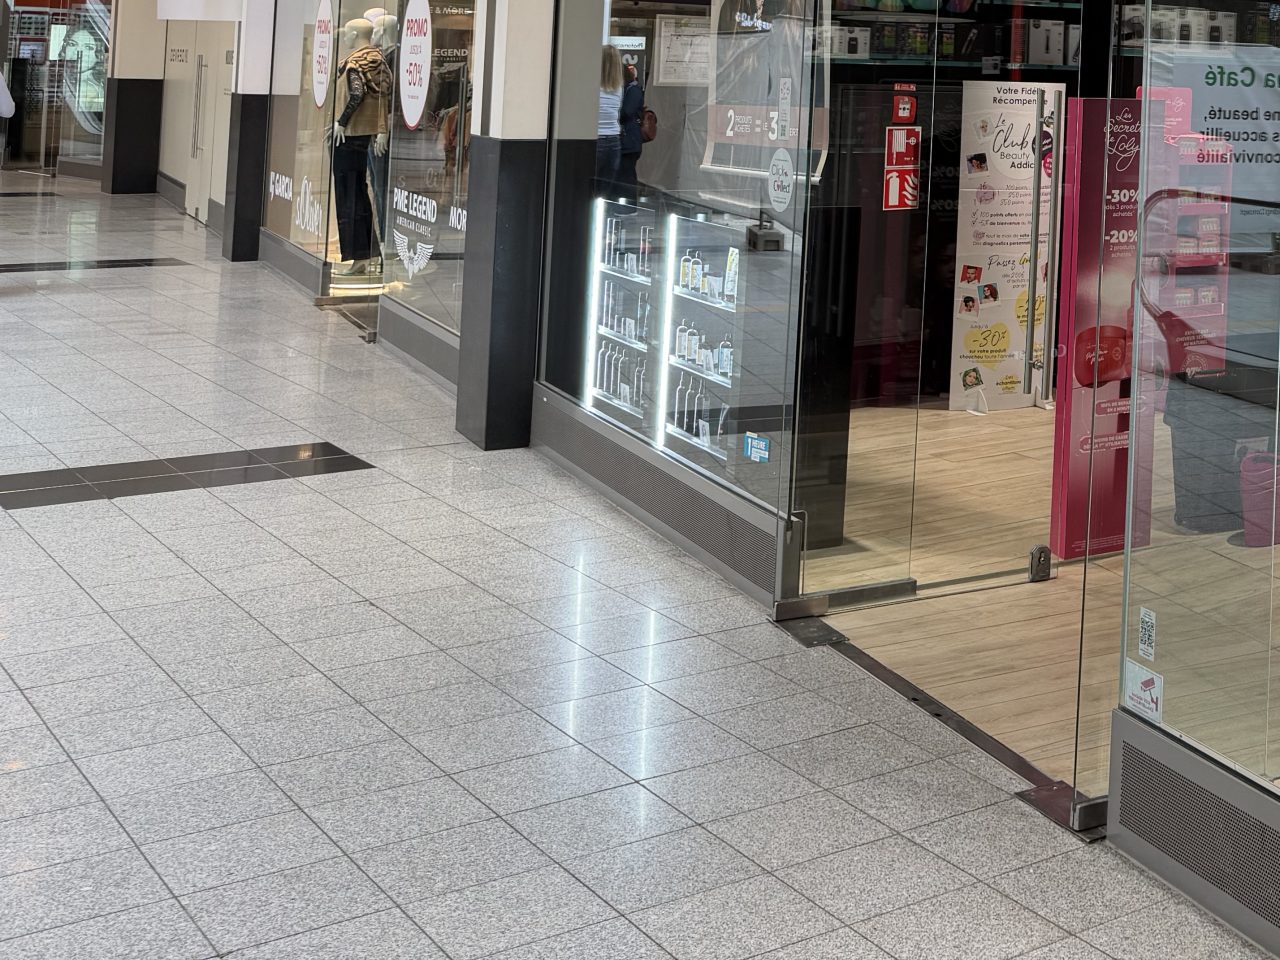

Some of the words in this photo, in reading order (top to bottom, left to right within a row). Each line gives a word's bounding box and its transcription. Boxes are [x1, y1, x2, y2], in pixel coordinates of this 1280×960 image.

[317, 19, 331, 34] PROMO
[406, 17, 428, 37] PROMO
[406, 62, 423, 87] -50%
[996, 87, 1018, 95] Votre
[725, 109, 735, 137] 2
[768, 111, 778, 140] 3
[992, 123, 1031, 154] Club
[1000, 152, 1030, 160] Beauty
[1107, 134, 1141, 172] Loly
[393, 187, 408, 214] PME
[408, 192, 437, 223] LEGEND
[396, 215, 415, 232] AMERICAN
[415, 220, 431, 237] CLASSIC
[987, 254, 1016, 271] Passez
[972, 329, 1007, 348] -30%
